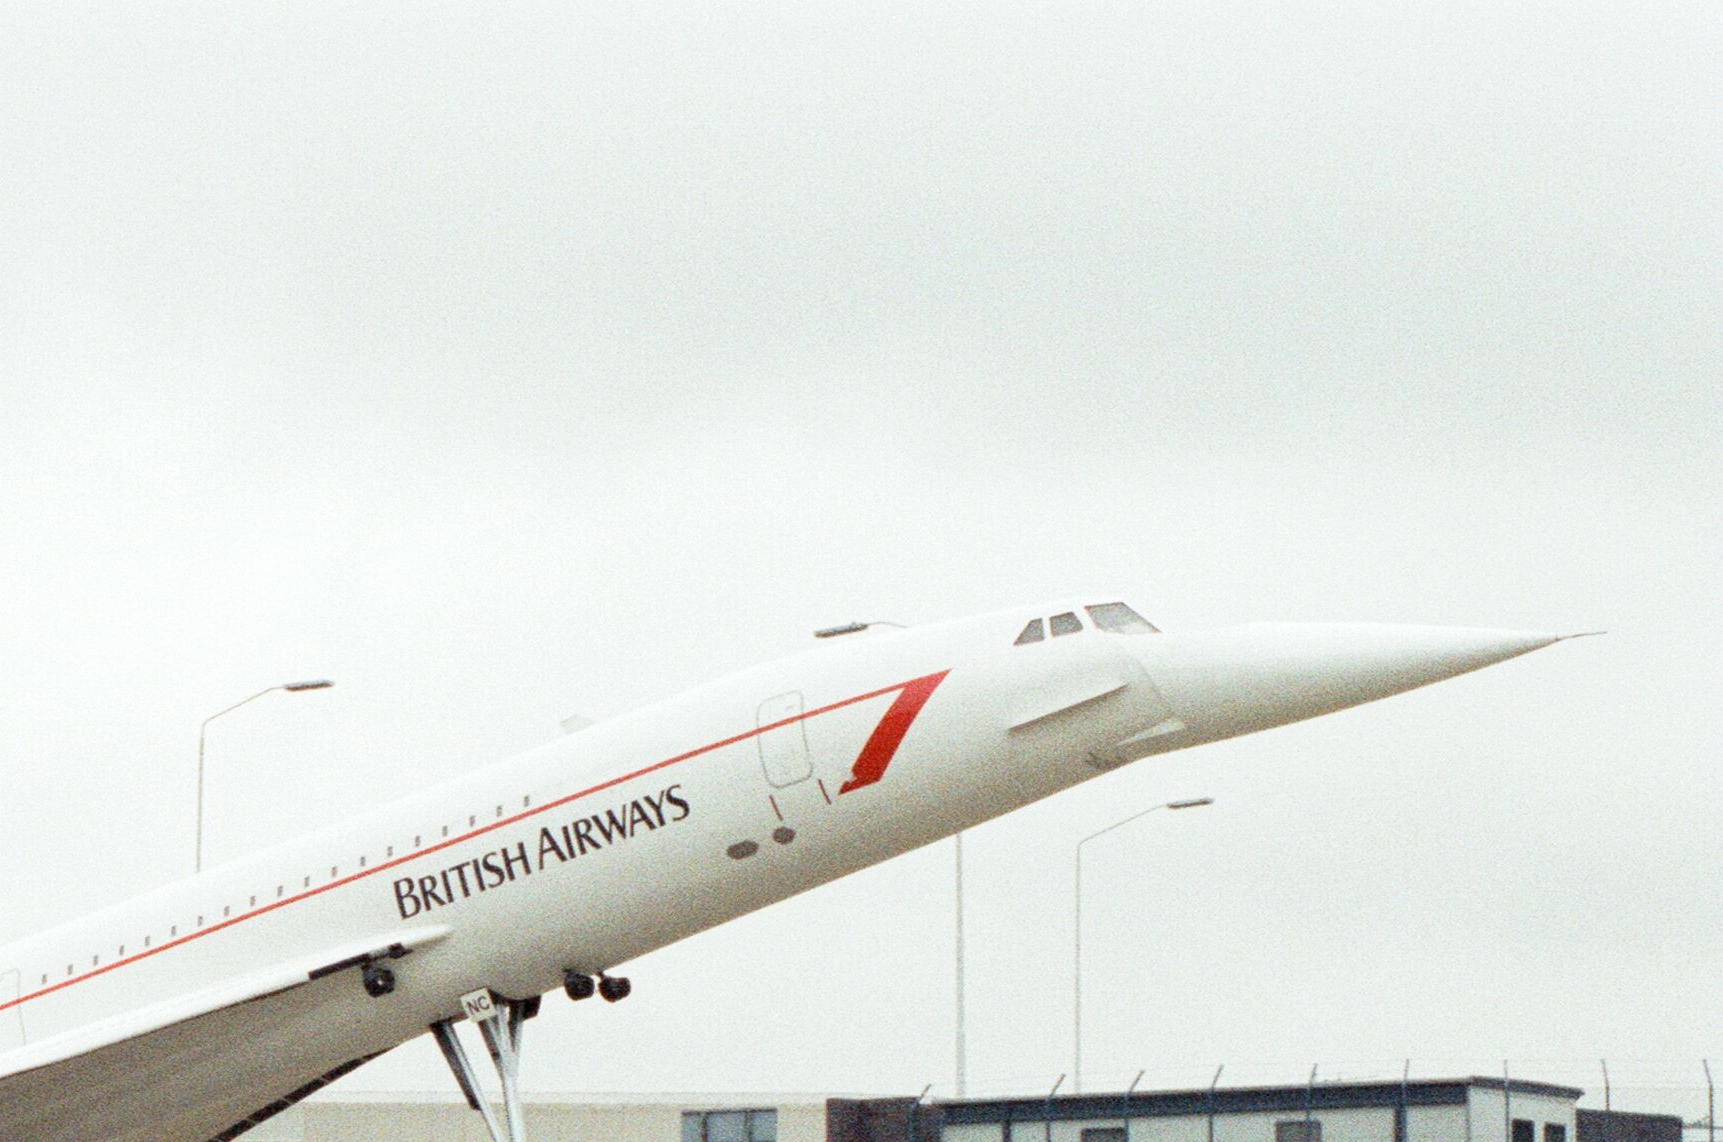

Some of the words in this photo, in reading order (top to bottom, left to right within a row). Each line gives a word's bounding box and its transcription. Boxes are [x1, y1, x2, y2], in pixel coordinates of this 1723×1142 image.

[393, 841, 532, 920] BRITISH
[538, 784, 690, 871] AIRWAYS
[466, 995, 491, 1015] NC
